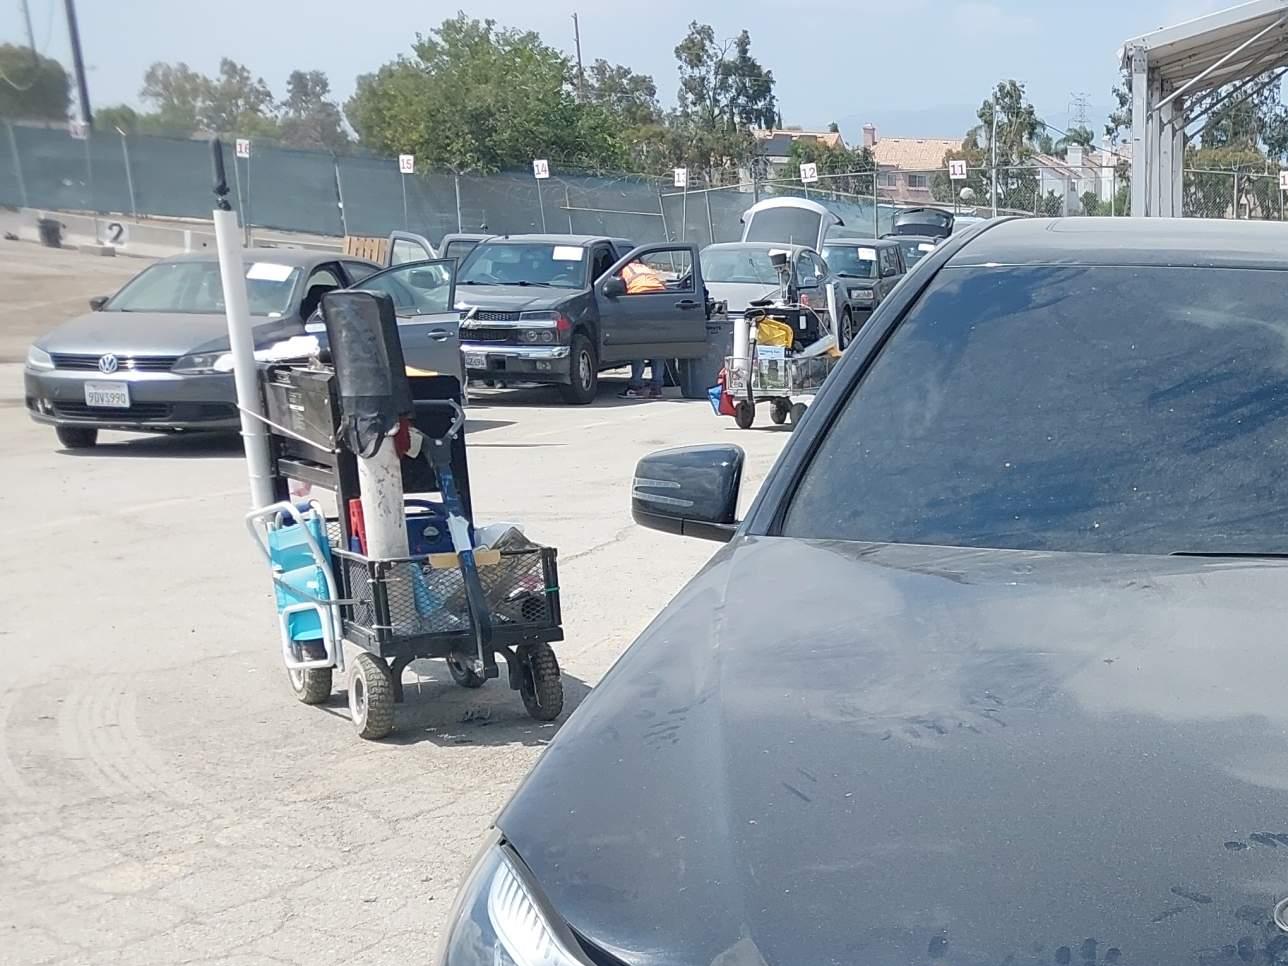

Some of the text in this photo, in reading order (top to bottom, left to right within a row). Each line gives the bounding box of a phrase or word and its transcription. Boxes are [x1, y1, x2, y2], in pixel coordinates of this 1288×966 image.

[401, 158, 412, 170] 15
[535, 163, 548, 176] 14
[950, 164, 965, 176] 11
[802, 167, 816, 179] 12
[108, 222, 124, 246] 2
